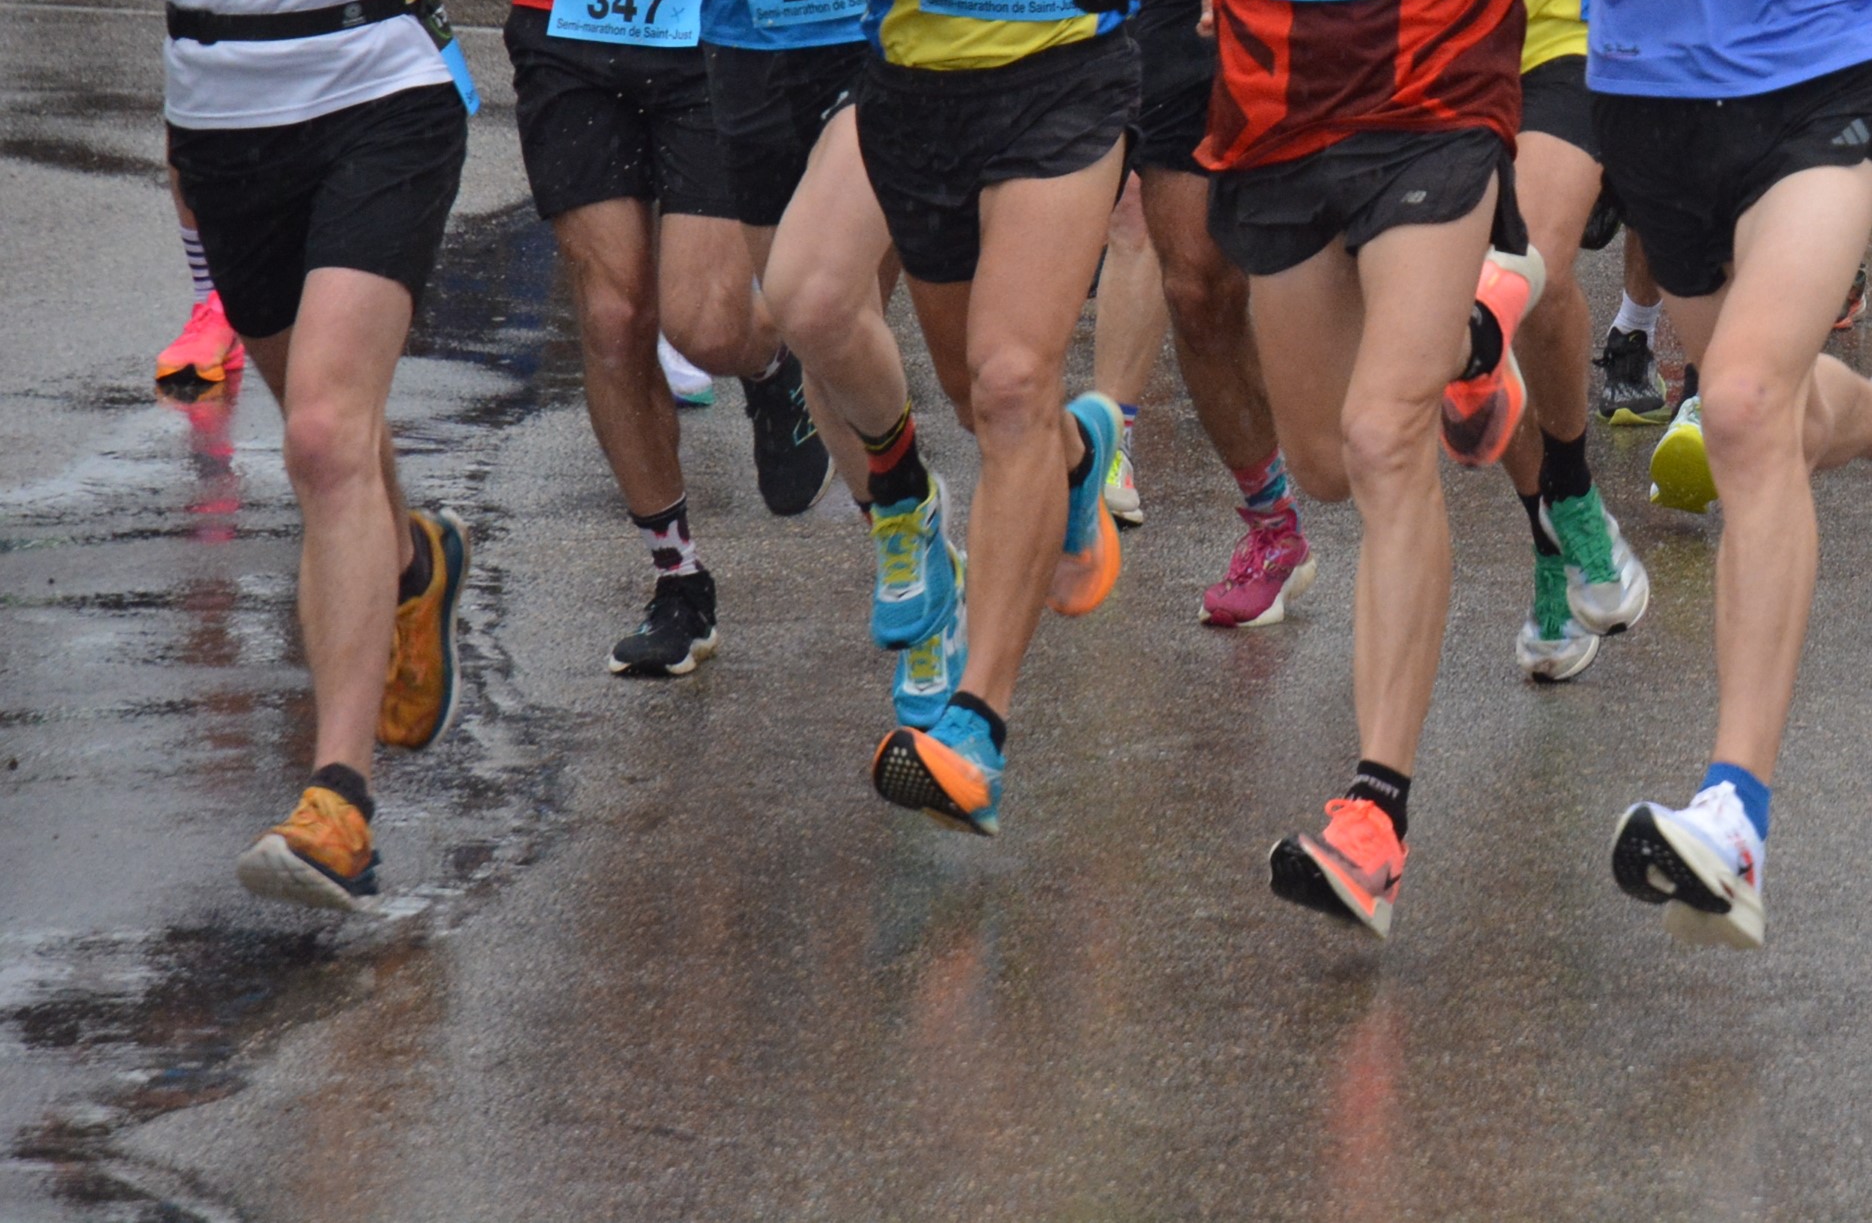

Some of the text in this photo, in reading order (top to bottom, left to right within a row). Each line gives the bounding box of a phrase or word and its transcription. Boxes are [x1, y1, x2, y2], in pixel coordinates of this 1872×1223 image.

[756, 2, 831, 19] Semi-marathon
[833, 0, 846, 10] de
[1011, 0, 1026, 13] de
[557, 17, 693, 40] Semi-marathon de Saint-Just
